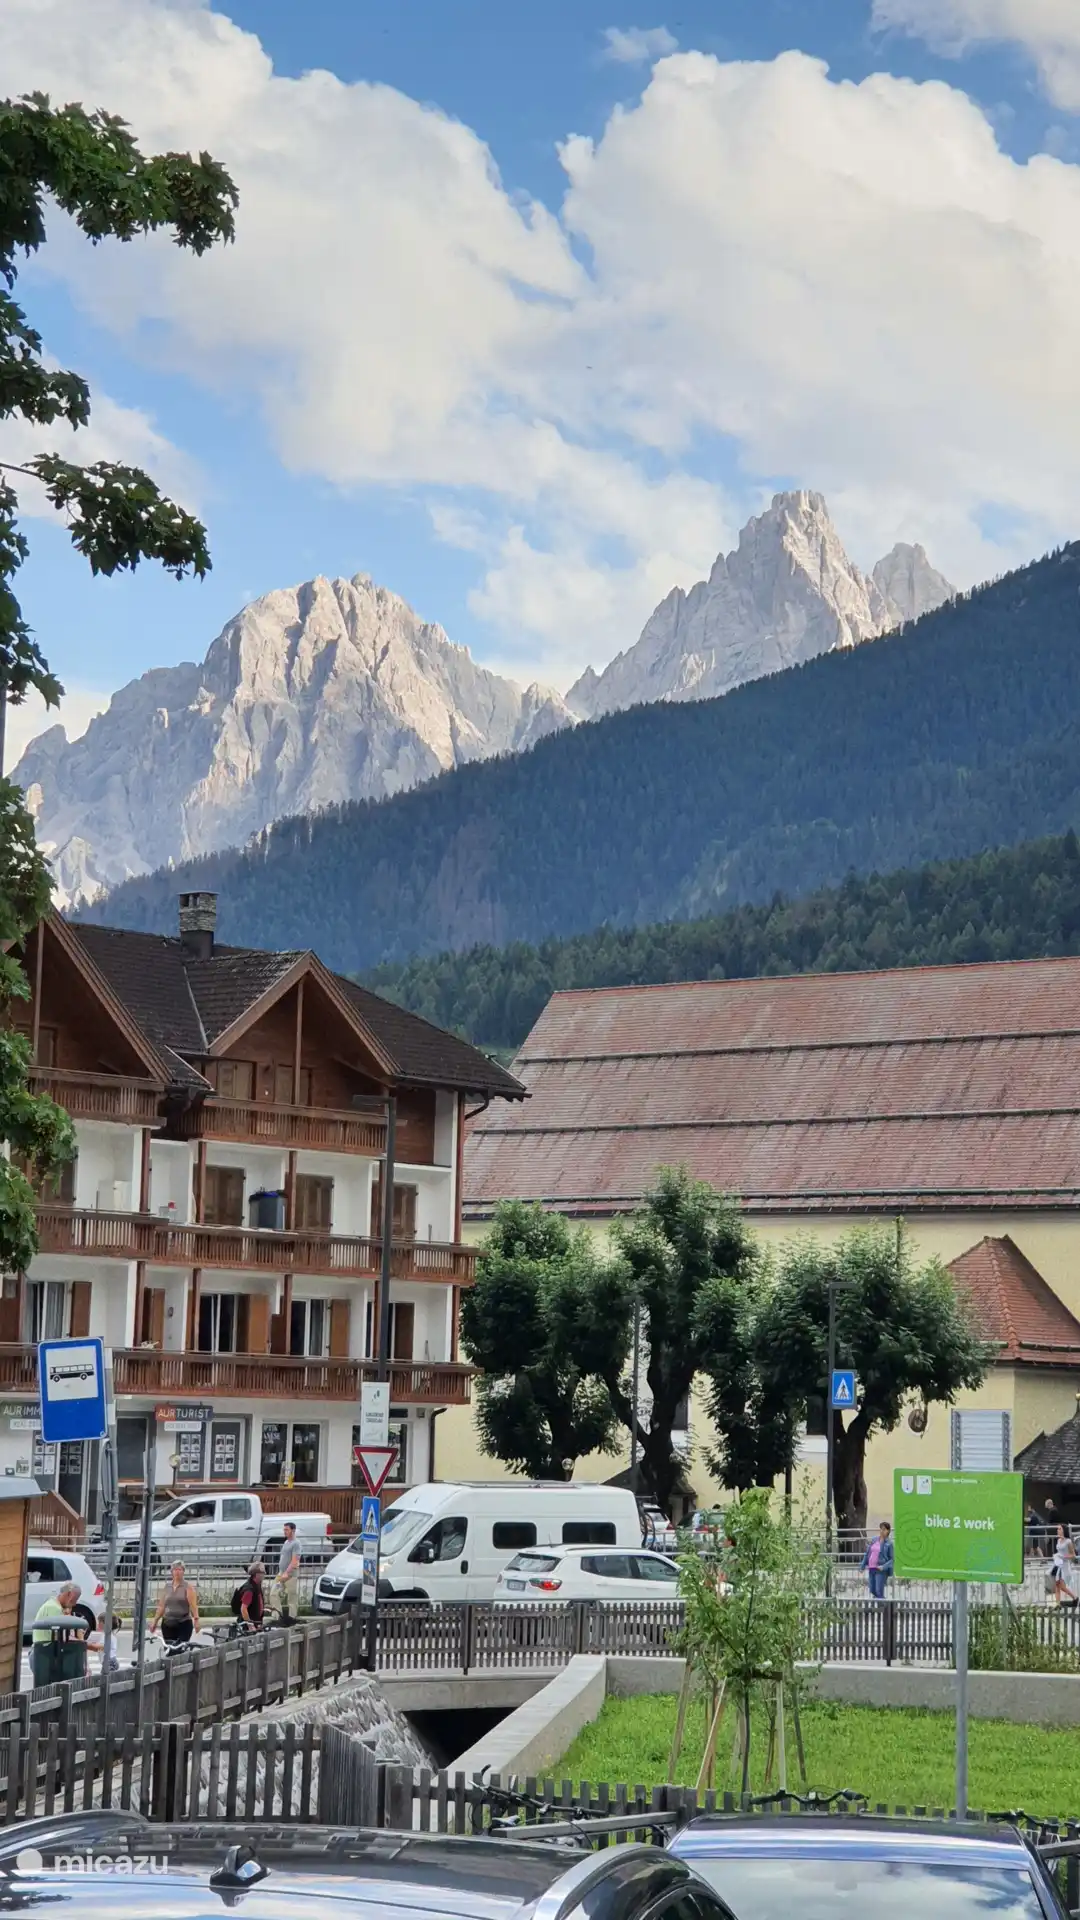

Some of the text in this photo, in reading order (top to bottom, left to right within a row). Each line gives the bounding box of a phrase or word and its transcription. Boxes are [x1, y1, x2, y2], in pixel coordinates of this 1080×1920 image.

[925, 1514, 995, 1531] bike 2 work
